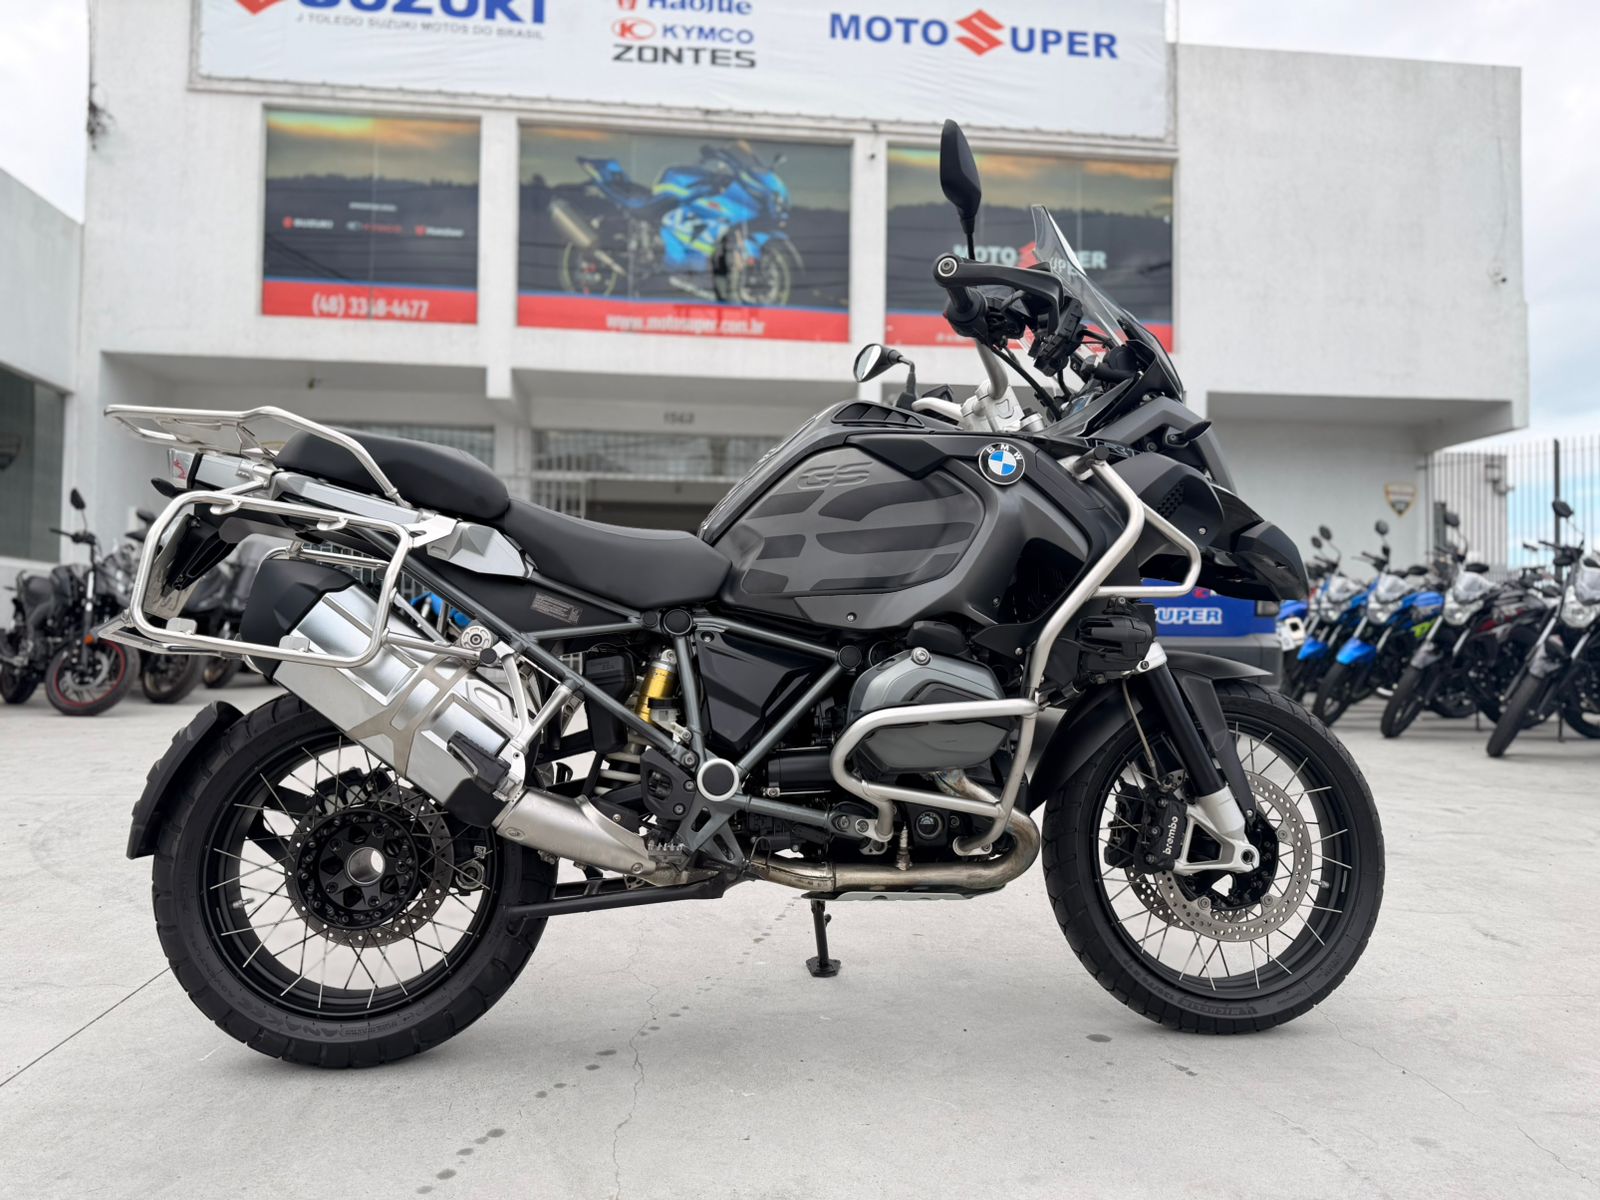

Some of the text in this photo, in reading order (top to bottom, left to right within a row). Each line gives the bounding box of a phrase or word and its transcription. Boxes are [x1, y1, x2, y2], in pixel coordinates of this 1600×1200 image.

[298, 0, 546, 24] UKI
[308, 14, 364, 27] TOLEDO
[367, 17, 416, 31] SUZUKI
[421, 22, 469, 35] MOTOS
[472, 25, 493, 36] DO
[496, 28, 544, 40] BRASIL
[662, 24, 755, 45] KYMCO
[829, 12, 949, 47] MOTO
[612, 44, 757, 70] ZONTES
[1154, 606, 1222, 624] UPER
[1162, 816, 1178, 855] brembo
